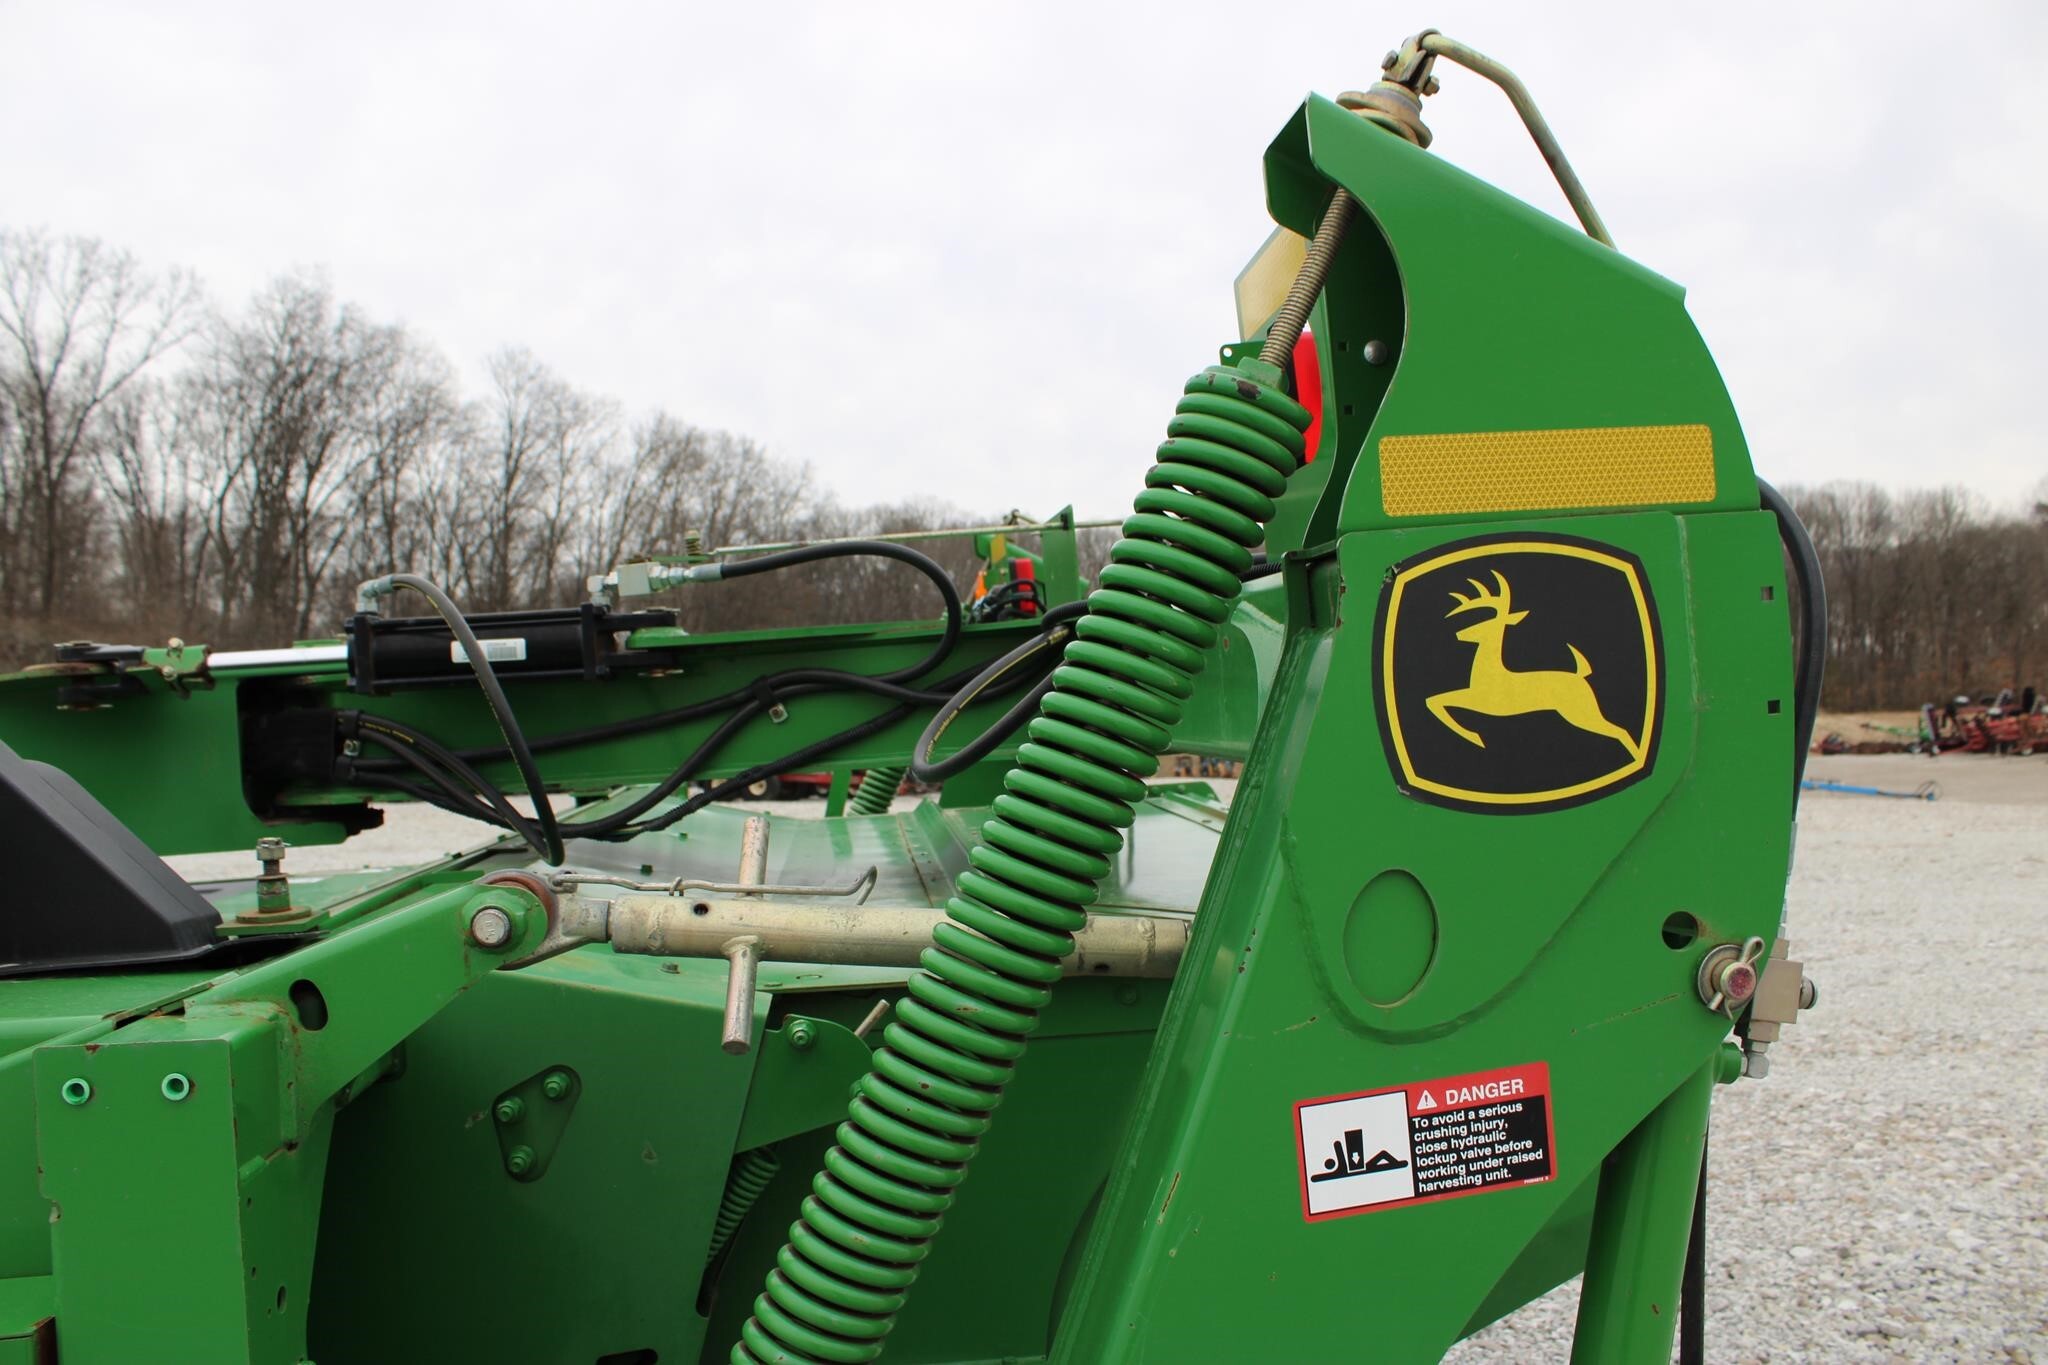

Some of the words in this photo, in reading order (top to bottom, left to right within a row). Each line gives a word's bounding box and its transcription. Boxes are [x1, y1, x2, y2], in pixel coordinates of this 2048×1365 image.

[1445, 1078, 1524, 1105] DANGER
[1412, 1117, 1429, 1129] To
[1432, 1110, 1465, 1126] avoid
[1468, 1110, 1476, 1120] a
[1478, 1102, 1523, 1118] serious
[1414, 1124, 1467, 1142] crushing
[1470, 1118, 1508, 1136] injury,
[1415, 1141, 1448, 1155] close
[1451, 1130, 1507, 1150] hydraulic
[1416, 1152, 1457, 1168] lockup
[1460, 1146, 1492, 1160] valve
[1495, 1139, 1533, 1152] before
[1417, 1163, 1466, 1180] working
[1469, 1157, 1504, 1171] under
[1507, 1148, 1543, 1165] raised
[1418, 1174, 1483, 1193] harvesting
[1485, 1167, 1512, 1181] unit.
